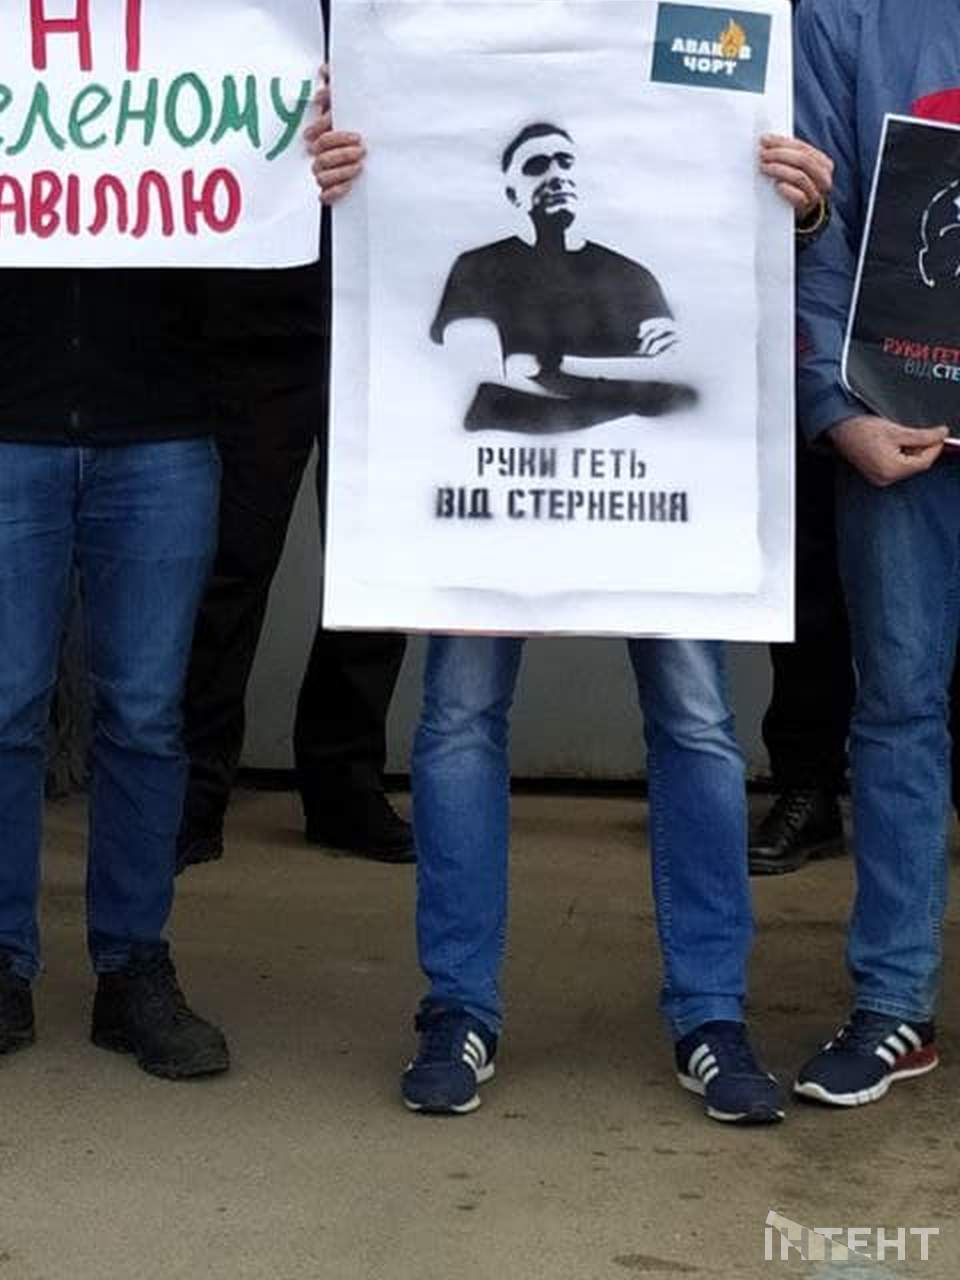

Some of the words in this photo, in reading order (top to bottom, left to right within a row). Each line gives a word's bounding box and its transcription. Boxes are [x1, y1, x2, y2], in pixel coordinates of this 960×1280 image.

[671, 37, 752, 61] АВАКОВ
[683, 56, 737, 75] ЧОРТ
[477, 446, 557, 478] РУКИ
[572, 448, 647, 479] ГЕТЬ
[436, 487, 494, 520] ВІД
[507, 489, 689, 523] СТЕРНЕНКА
